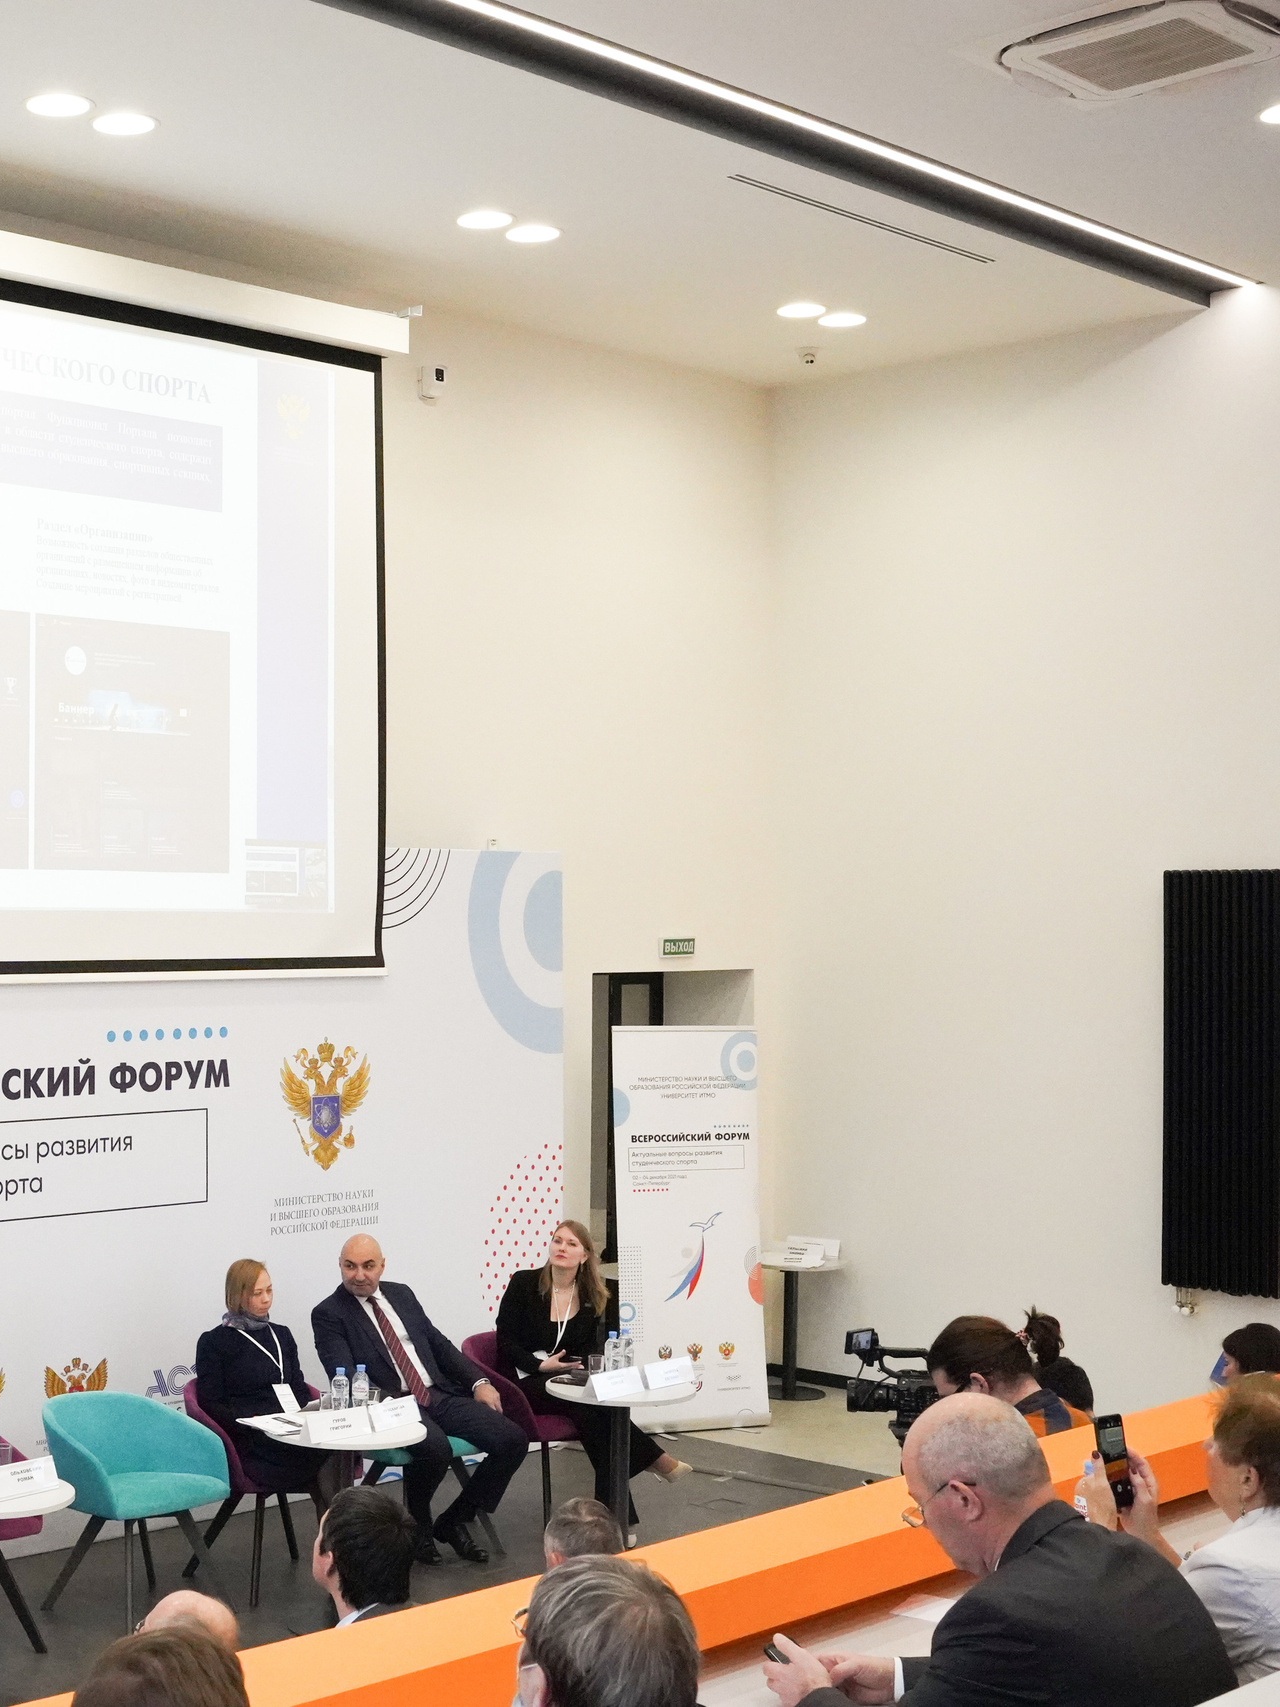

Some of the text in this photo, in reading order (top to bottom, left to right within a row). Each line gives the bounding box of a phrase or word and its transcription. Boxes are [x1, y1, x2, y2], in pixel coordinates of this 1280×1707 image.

[123, 367, 211, 403] СПОРТА
[58, 702, 95, 716] Баннер
[664, 942, 694, 953] ВЫХОД
[110, 1059, 229, 1093] ФОРУМ
[637, 1075, 683, 1083] МИНИСТЕРСТВО
[628, 1083, 671, 1091] ОБРАЗОВАНИЯ
[671, 1082, 711, 1090] РОССИЙСКОЙ
[631, 1132, 750, 1143] ВСЕРОССИЙСКИЙ ФОРУМ
[37, 1136, 132, 1162] развития
[274, 1188, 374, 1207] МИНИСТЕРСТВО НАУКИ
[270, 1201, 380, 1222] И ВЫСШЕГО ОБРАЗОВАНИЯ
[270, 1215, 379, 1236] РОССИЙСКОЙ ФЕДЕРАЦИИ
[17, 1475, 34, 1483] РОМАН
